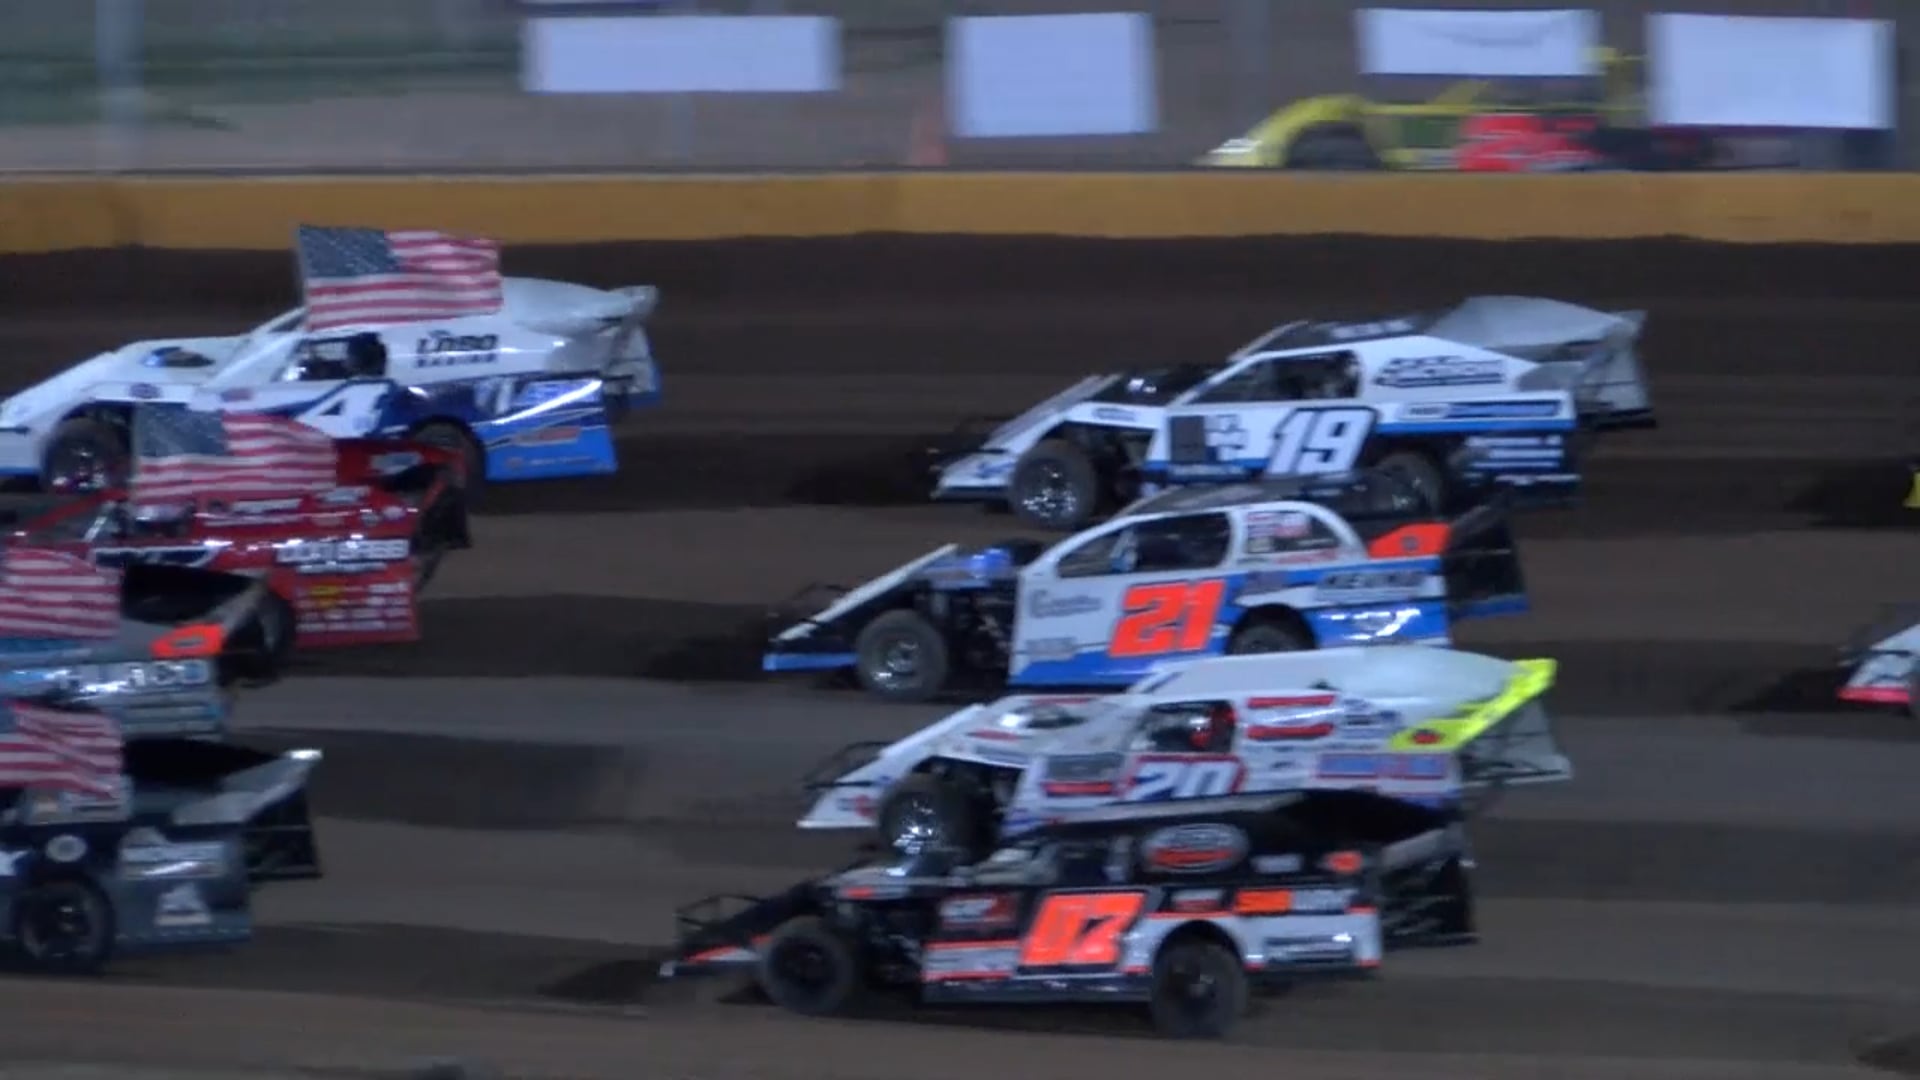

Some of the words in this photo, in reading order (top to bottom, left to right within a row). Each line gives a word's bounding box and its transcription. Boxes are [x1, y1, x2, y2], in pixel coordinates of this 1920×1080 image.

[294, 382, 393, 438] 4
[1267, 408, 1377, 475] 19
[1108, 578, 1227, 658] 21
[1020, 892, 1146, 966] 07
